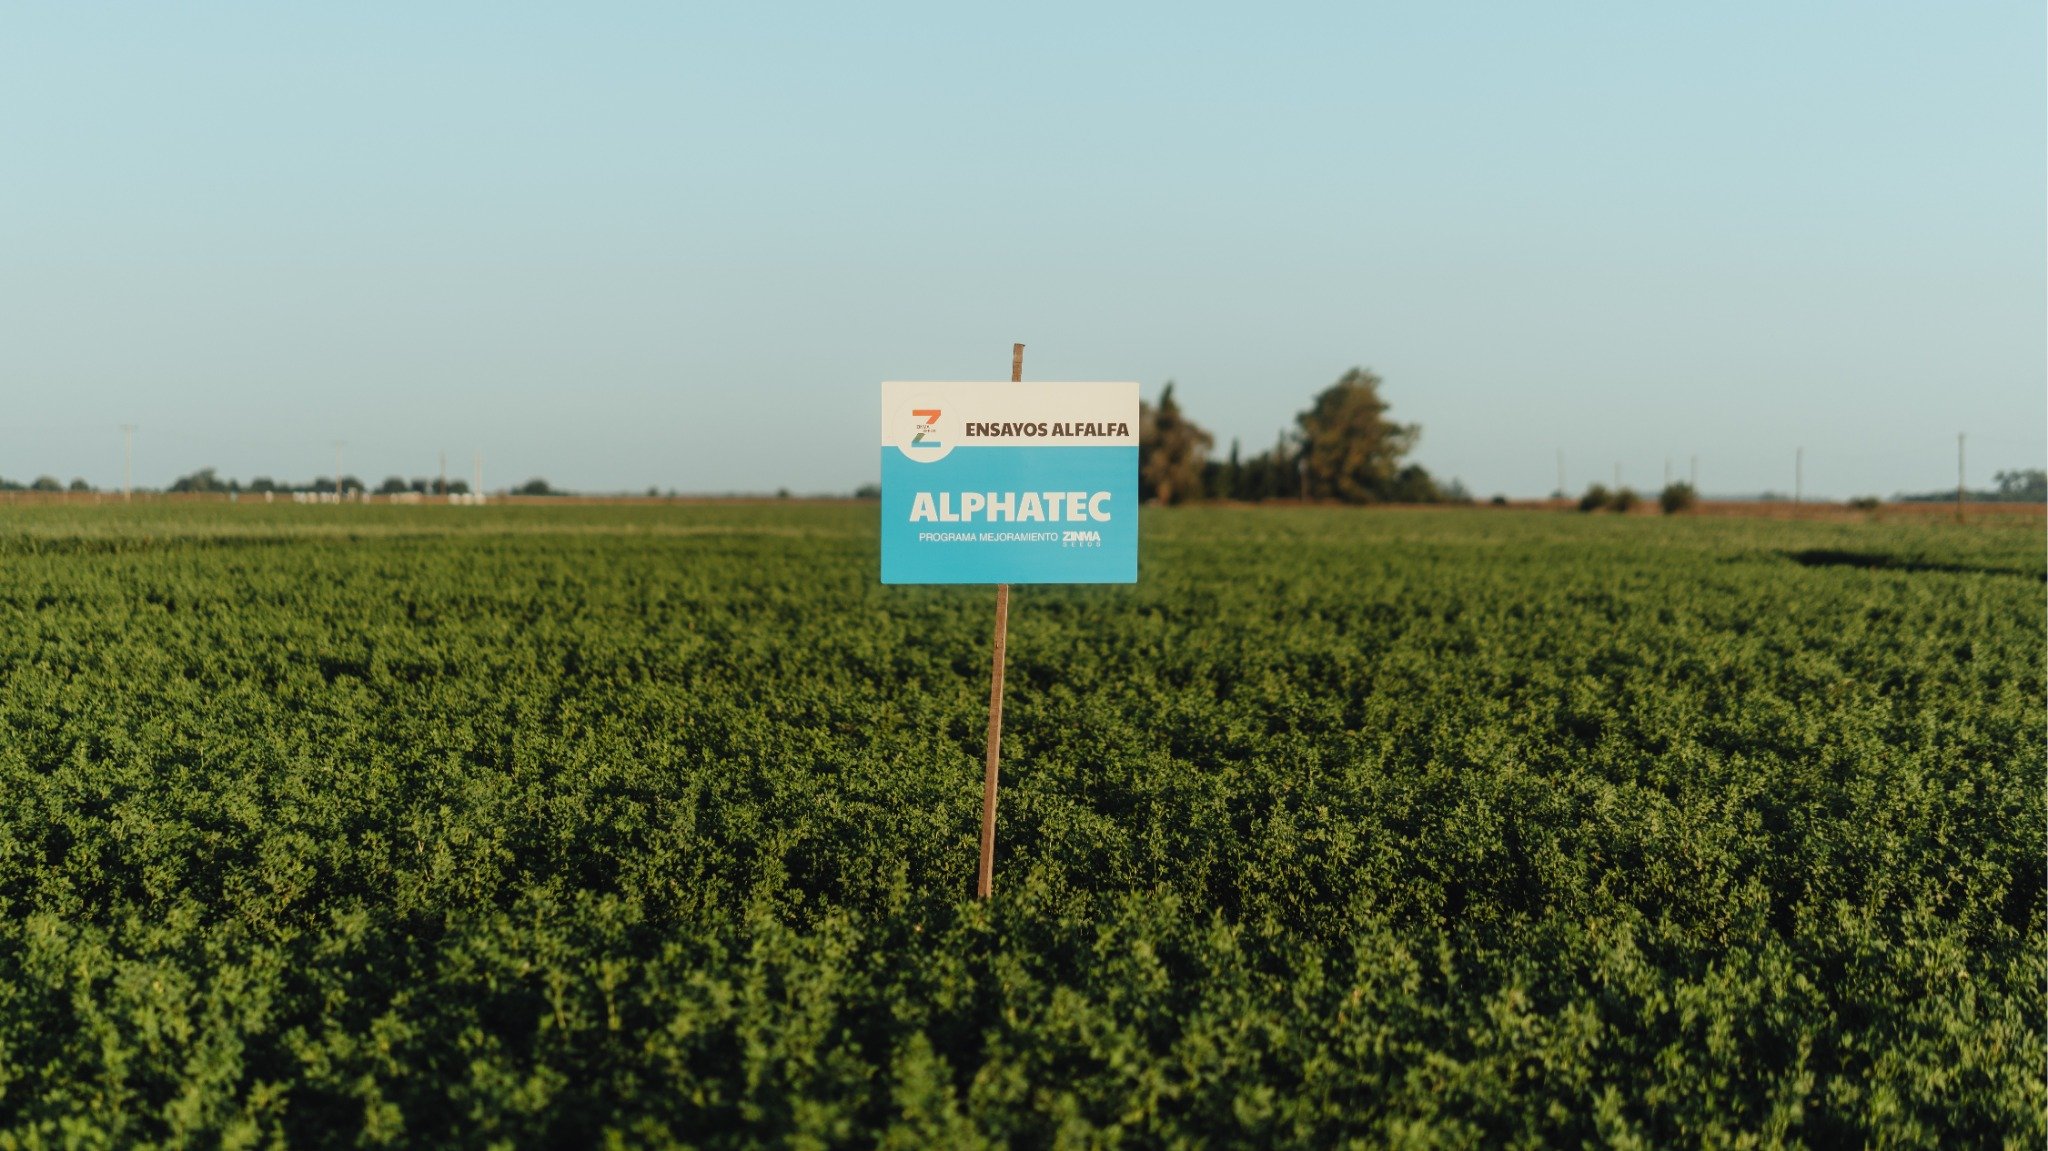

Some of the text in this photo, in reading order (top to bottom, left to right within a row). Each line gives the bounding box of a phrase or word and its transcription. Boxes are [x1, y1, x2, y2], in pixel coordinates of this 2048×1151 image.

[965, 422, 1130, 437] ENSAYOS ALFALFA
[909, 491, 1112, 522] ALPHATEC
[919, 531, 1101, 542] PROGRAMA MEJORAMIENTO ZINMA
